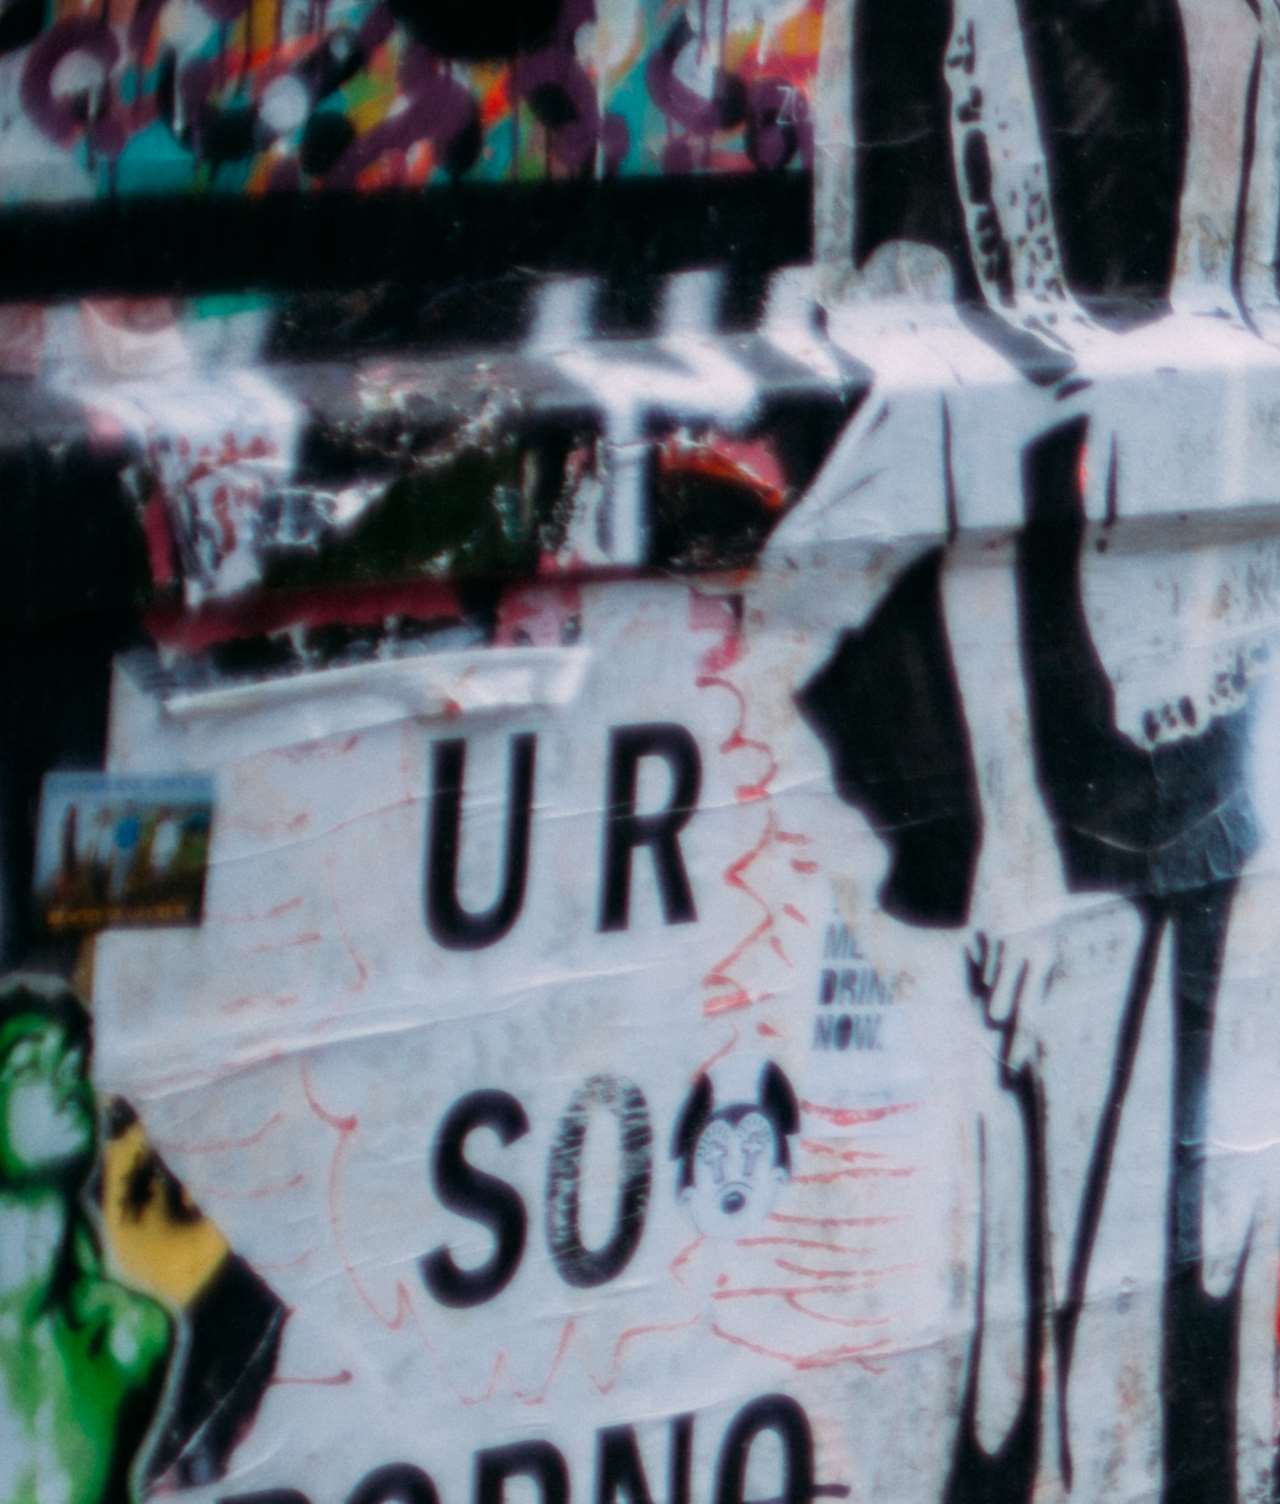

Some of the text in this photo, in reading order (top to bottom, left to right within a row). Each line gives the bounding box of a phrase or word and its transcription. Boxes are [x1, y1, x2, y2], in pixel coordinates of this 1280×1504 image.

[422, 721, 703, 953] U R
[419, 1073, 653, 1310] SO
